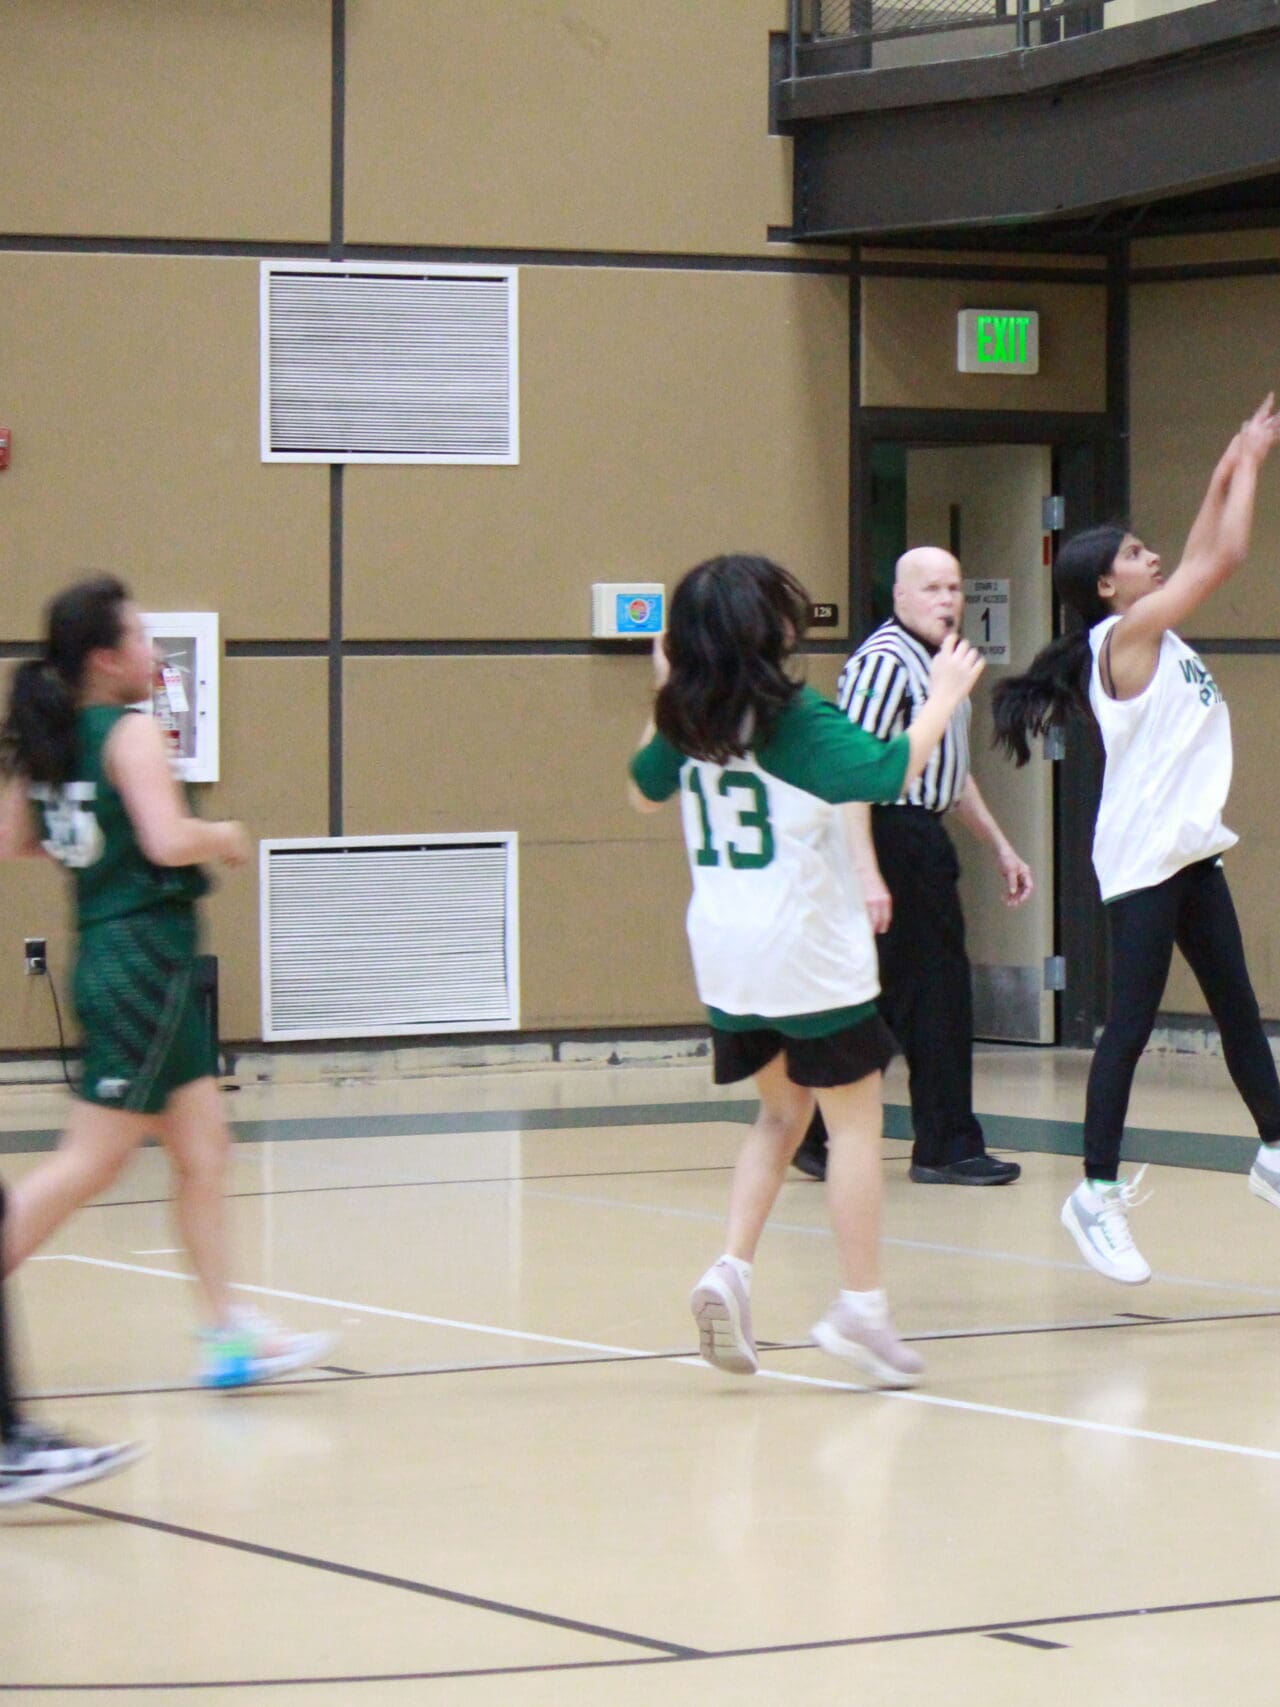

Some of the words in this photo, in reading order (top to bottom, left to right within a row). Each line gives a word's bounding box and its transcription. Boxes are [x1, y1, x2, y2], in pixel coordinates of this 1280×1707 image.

[976, 315, 1030, 363] EXIT
[981, 607, 990, 642] 1
[689, 766, 775, 869] 13
